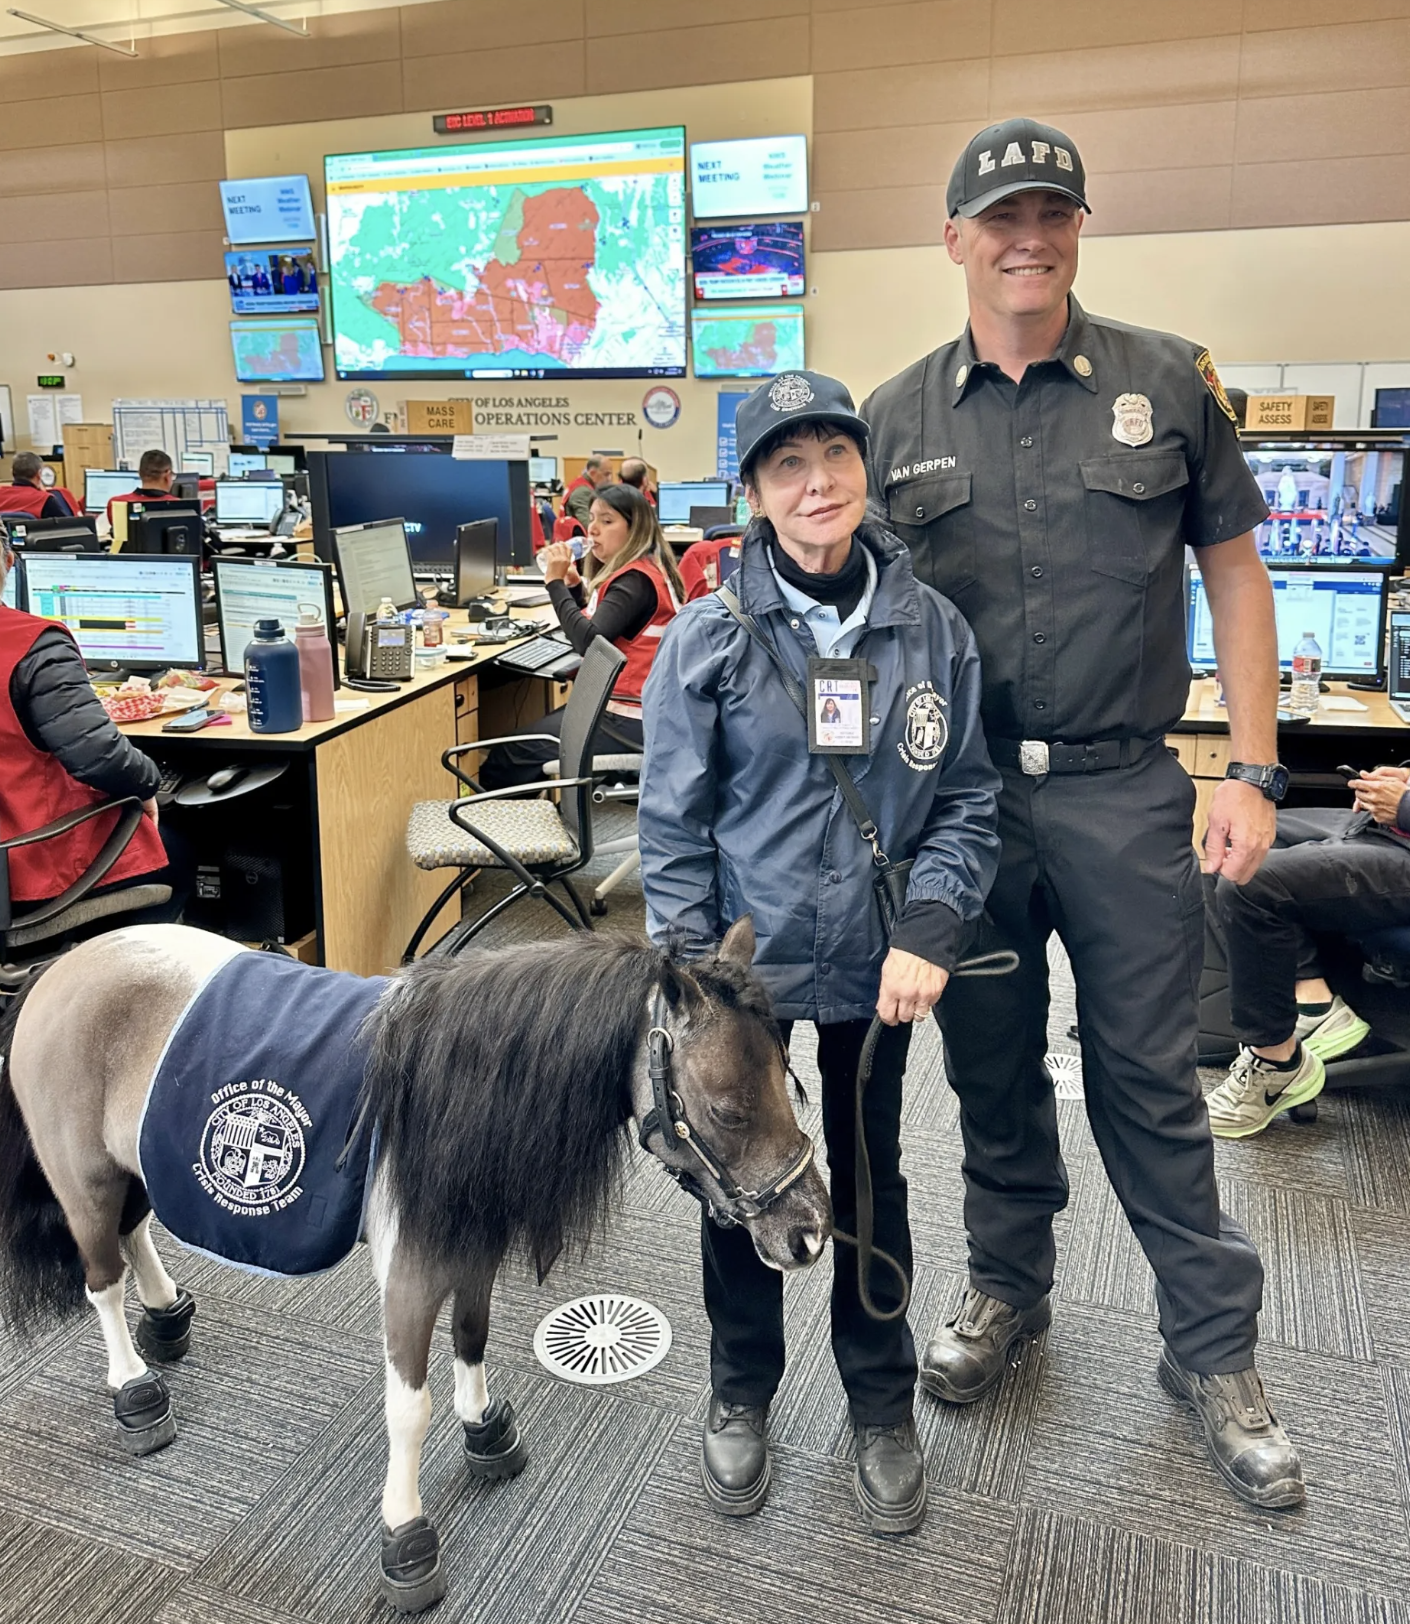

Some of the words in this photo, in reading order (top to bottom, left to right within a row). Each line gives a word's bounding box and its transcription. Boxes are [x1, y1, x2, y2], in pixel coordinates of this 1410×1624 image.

[462, 112, 486, 127] LEVEL
[494, 107, 535, 124] ACTIVATION
[978, 141, 1074, 176] LAFD
[697, 160, 722, 170] NEXT
[698, 172, 741, 183] MEETING
[226, 194, 246, 204] NEXT
[228, 204, 262, 215] MEETING
[475, 397, 491, 408] OF
[492, 397, 514, 408] LOS
[515, 397, 570, 408] ANGELES
[1259, 401, 1292, 411] SAFETY
[426, 406, 455, 416] MASS
[428, 418, 455, 428] CARE
[474, 412, 571, 426] OPERATIONS
[574, 412, 638, 426] CENTER
[1258, 414, 1292, 424] ASSESS
[891, 465, 910, 481] VAN
[912, 456, 956, 475] GERPEN
[820, 680, 838, 692] CRT
[210, 1080, 248, 1104] Office
[251, 1078, 266, 1090] of
[266, 1079, 285, 1096] the
[283, 1090, 313, 1128] Mayor
[212, 1106, 232, 1126] CITY
[232, 1098, 248, 1110] OF
[250, 1098, 270, 1109] LOS
[269, 1105, 300, 1149] ANGELES
[192, 1162, 214, 1195] Crisis
[214, 1192, 270, 1216] Response
[270, 1185, 304, 1212] Team
[211, 1171, 257, 1200] FOUNDED
[260, 1186, 280, 1199] 1781
